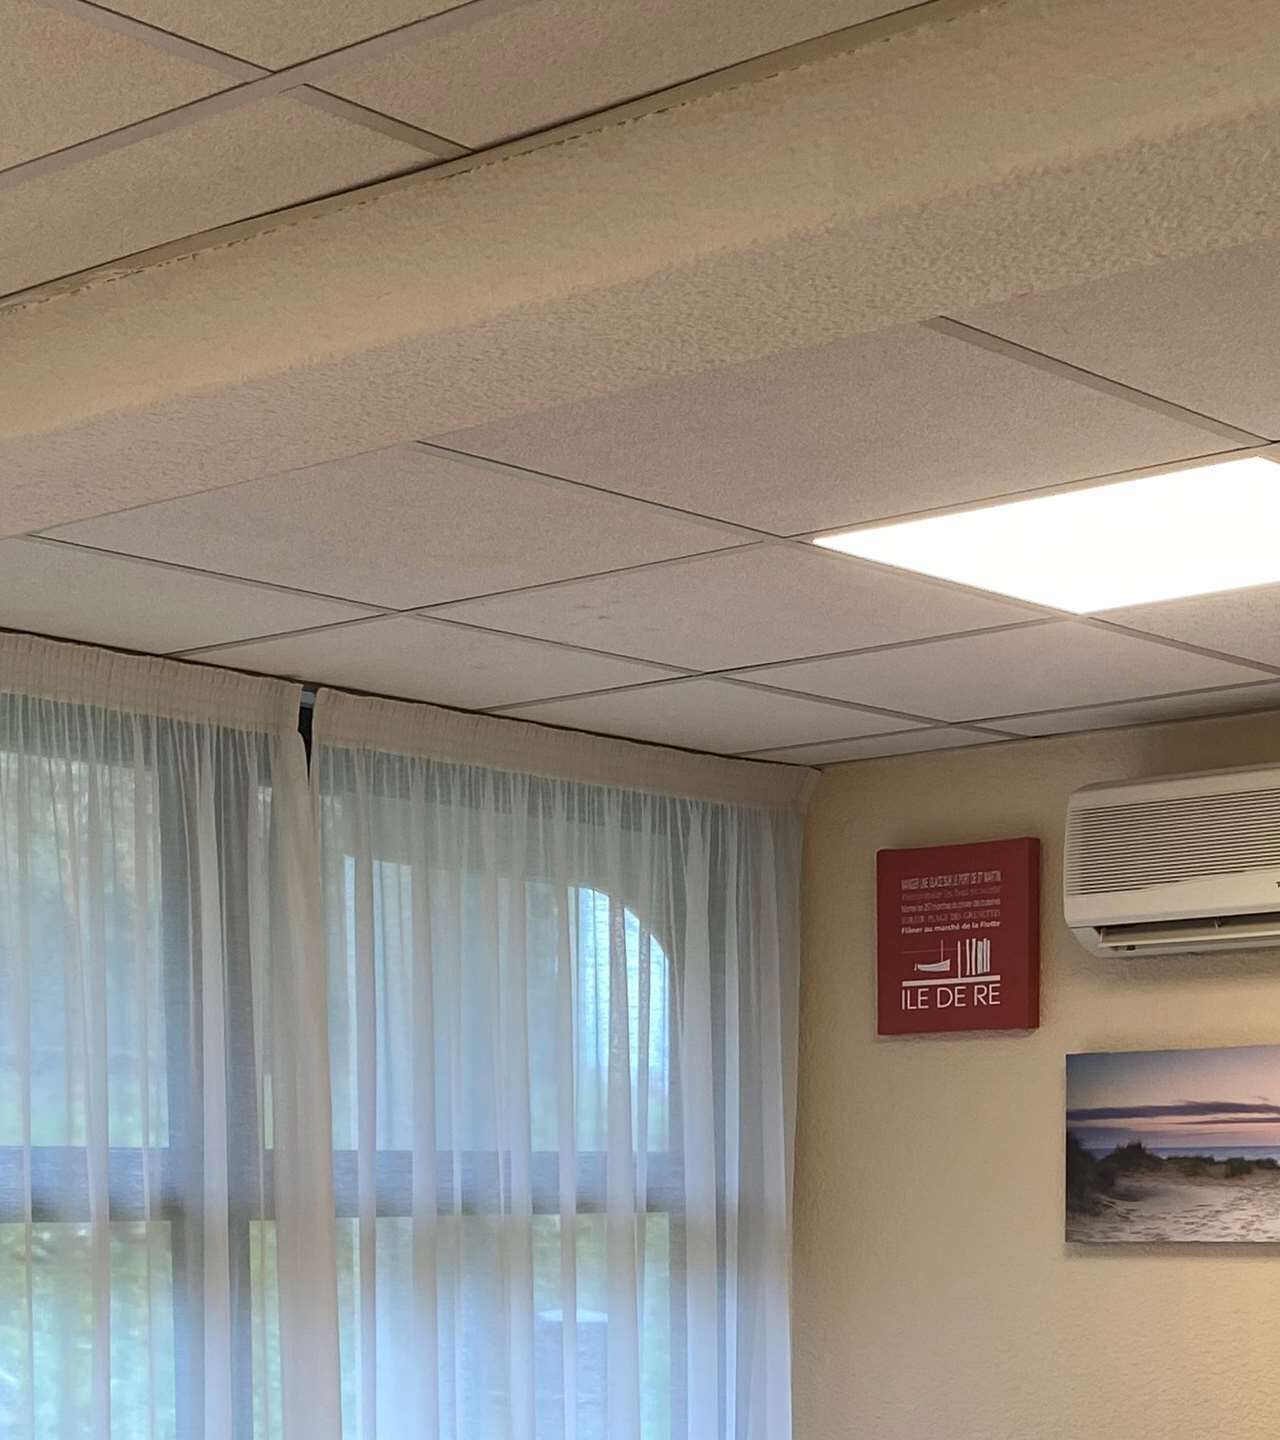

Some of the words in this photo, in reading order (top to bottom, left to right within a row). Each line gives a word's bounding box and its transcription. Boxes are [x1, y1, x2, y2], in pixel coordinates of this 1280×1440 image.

[961, 922, 971, 930] de
[971, 921, 979, 929] la
[901, 987, 929, 1010] ILE
[936, 985, 967, 1009] DE
[974, 983, 1001, 1006] RE
